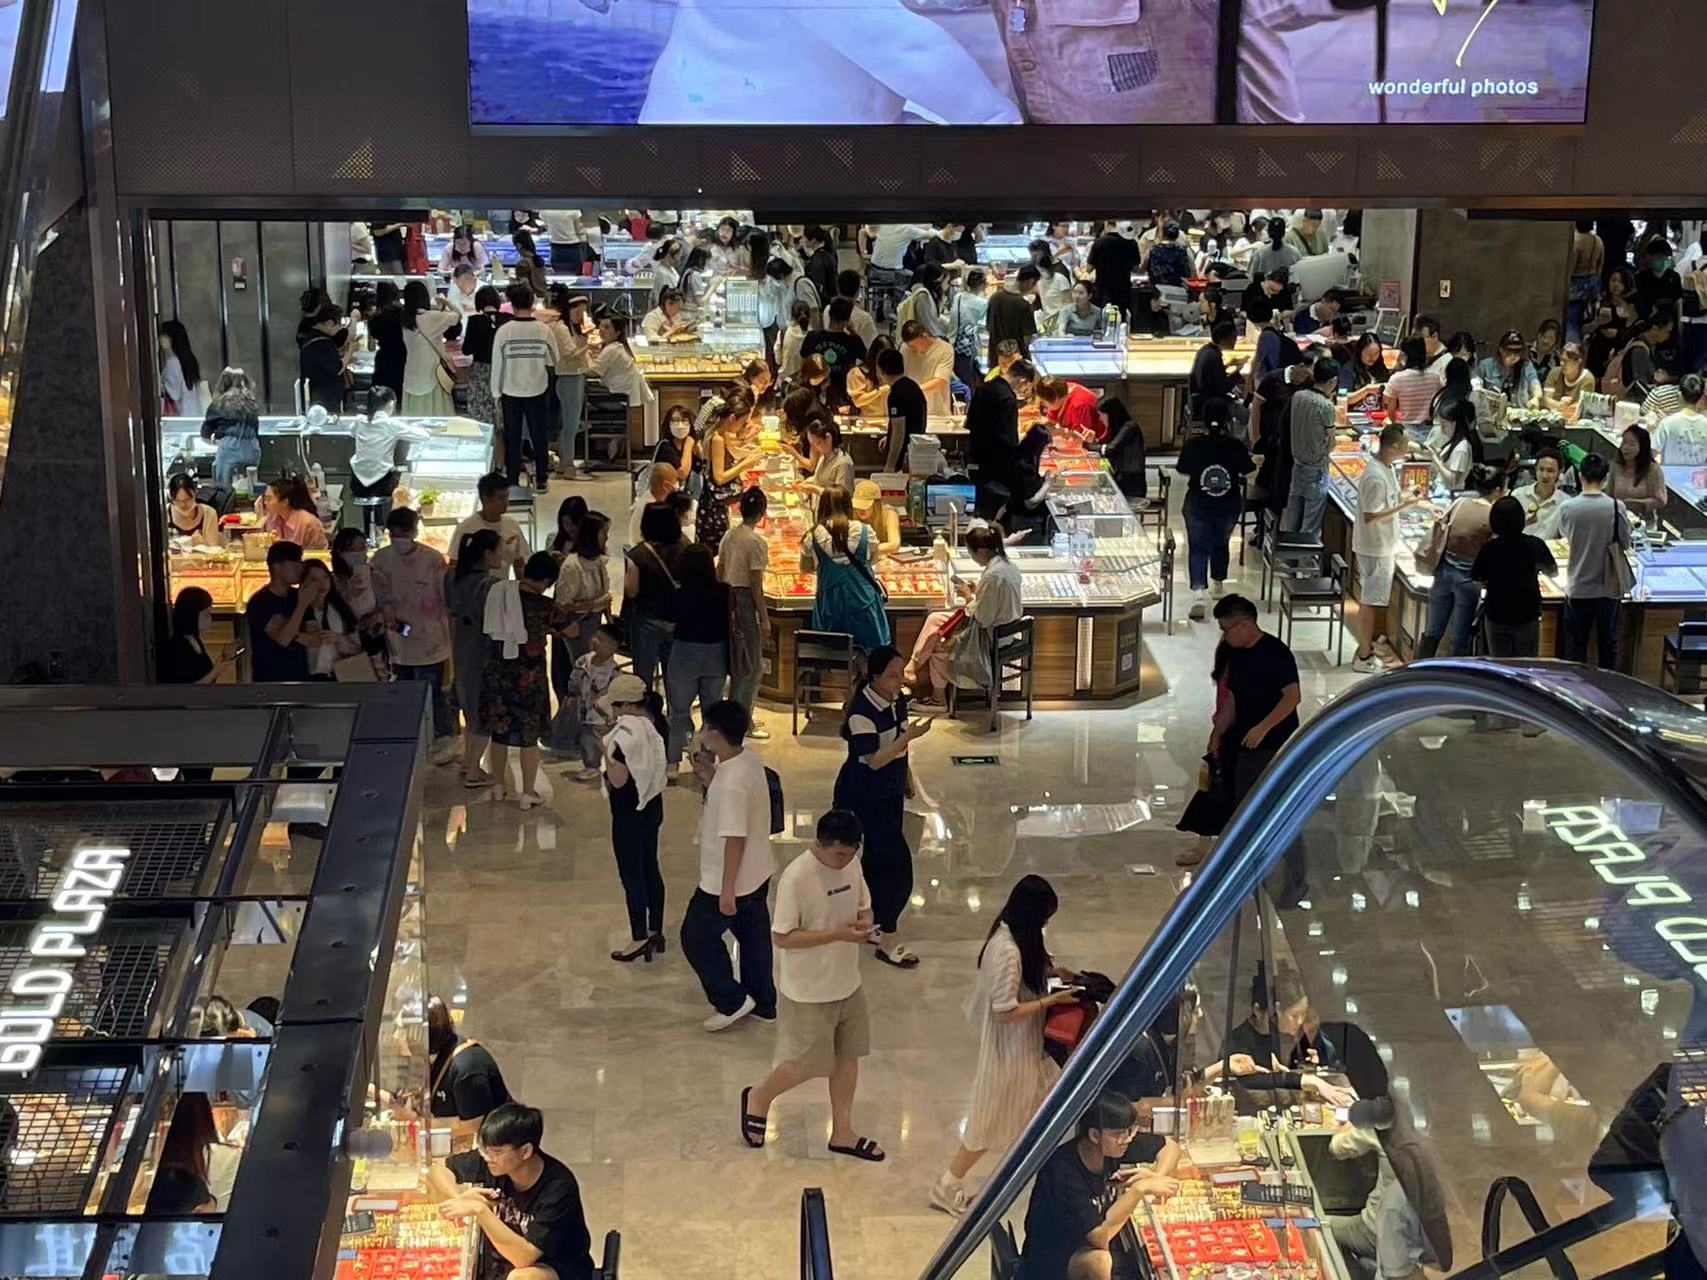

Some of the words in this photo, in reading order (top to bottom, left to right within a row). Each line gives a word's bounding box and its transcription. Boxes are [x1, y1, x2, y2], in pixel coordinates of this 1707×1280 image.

[1368, 78, 1465, 95] wonderful
[1471, 78, 1539, 98] photos
[31, 848, 131, 957] PLAZA
[0, 968, 74, 1079] GOLD
